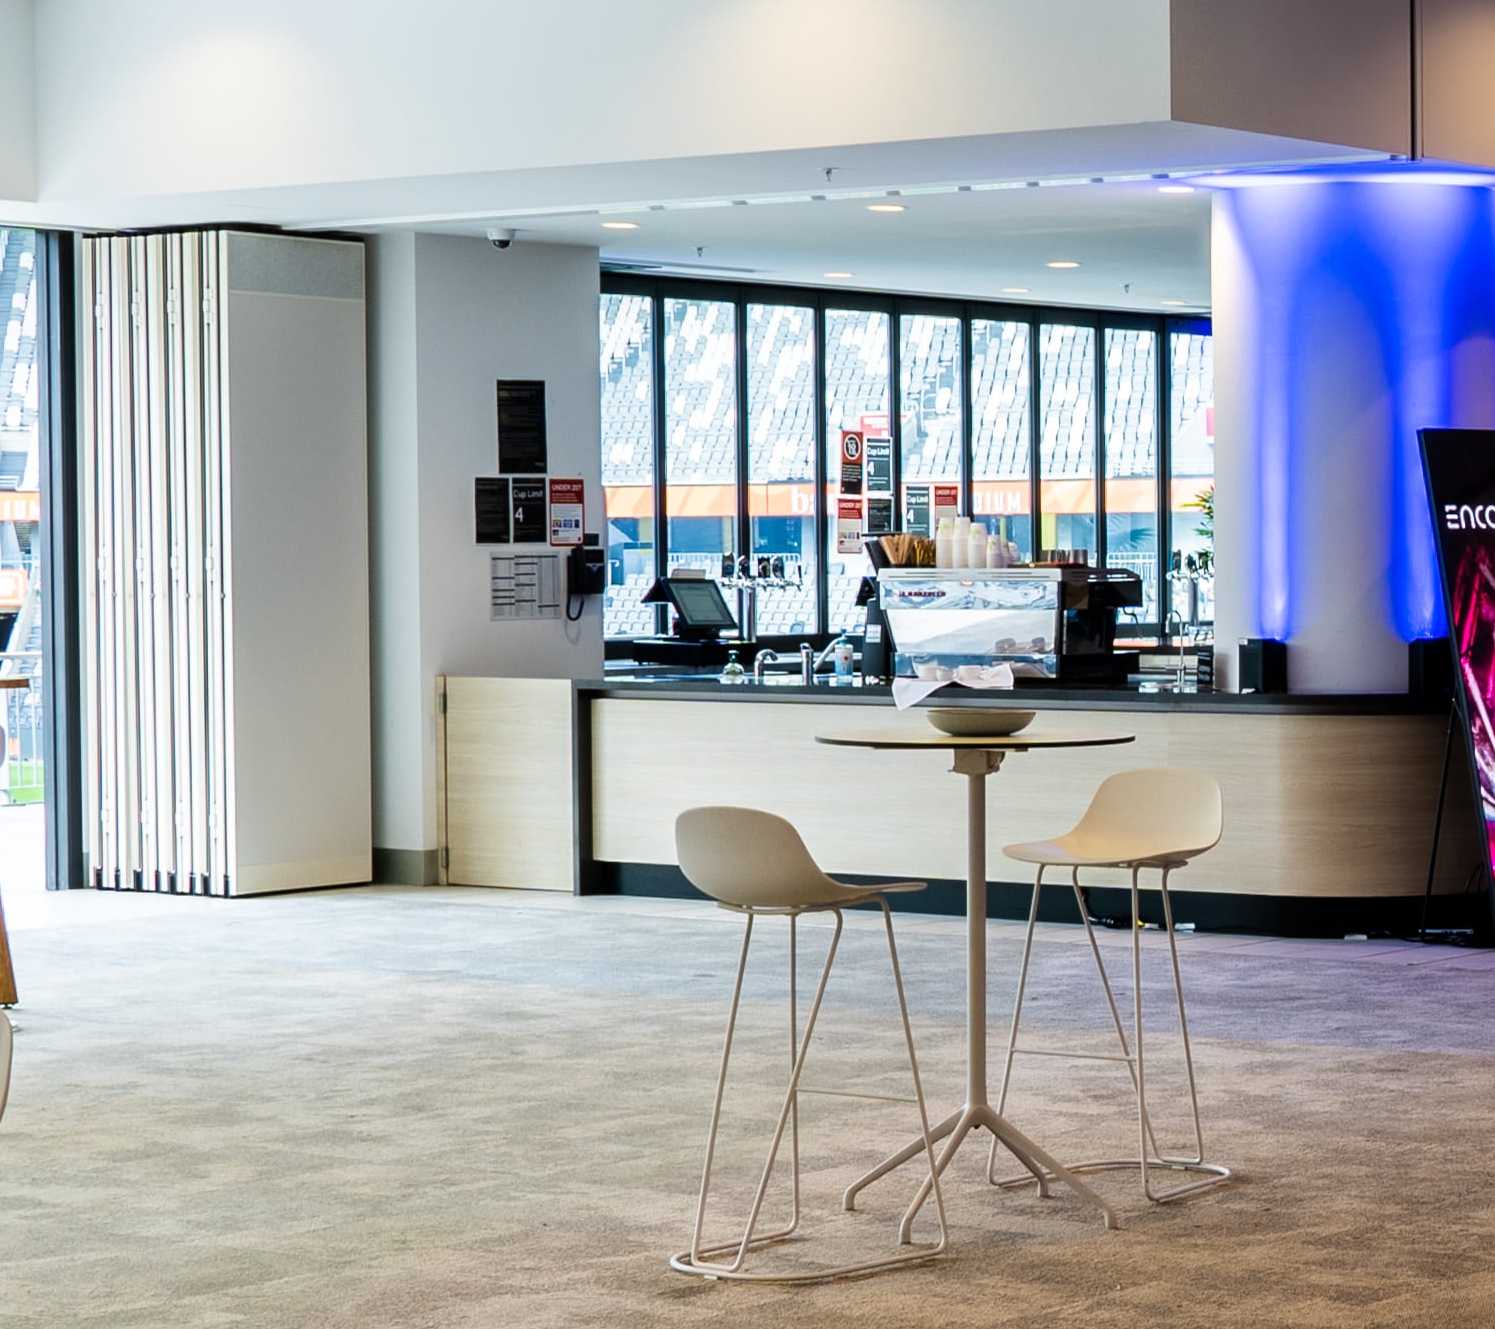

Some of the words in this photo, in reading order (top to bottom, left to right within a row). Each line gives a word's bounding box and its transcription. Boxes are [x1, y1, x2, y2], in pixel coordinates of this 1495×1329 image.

[868, 461, 875, 476] 4
[513, 489, 526, 499] Cup
[515, 506, 523, 523] 4
[906, 509, 914, 523] 4
